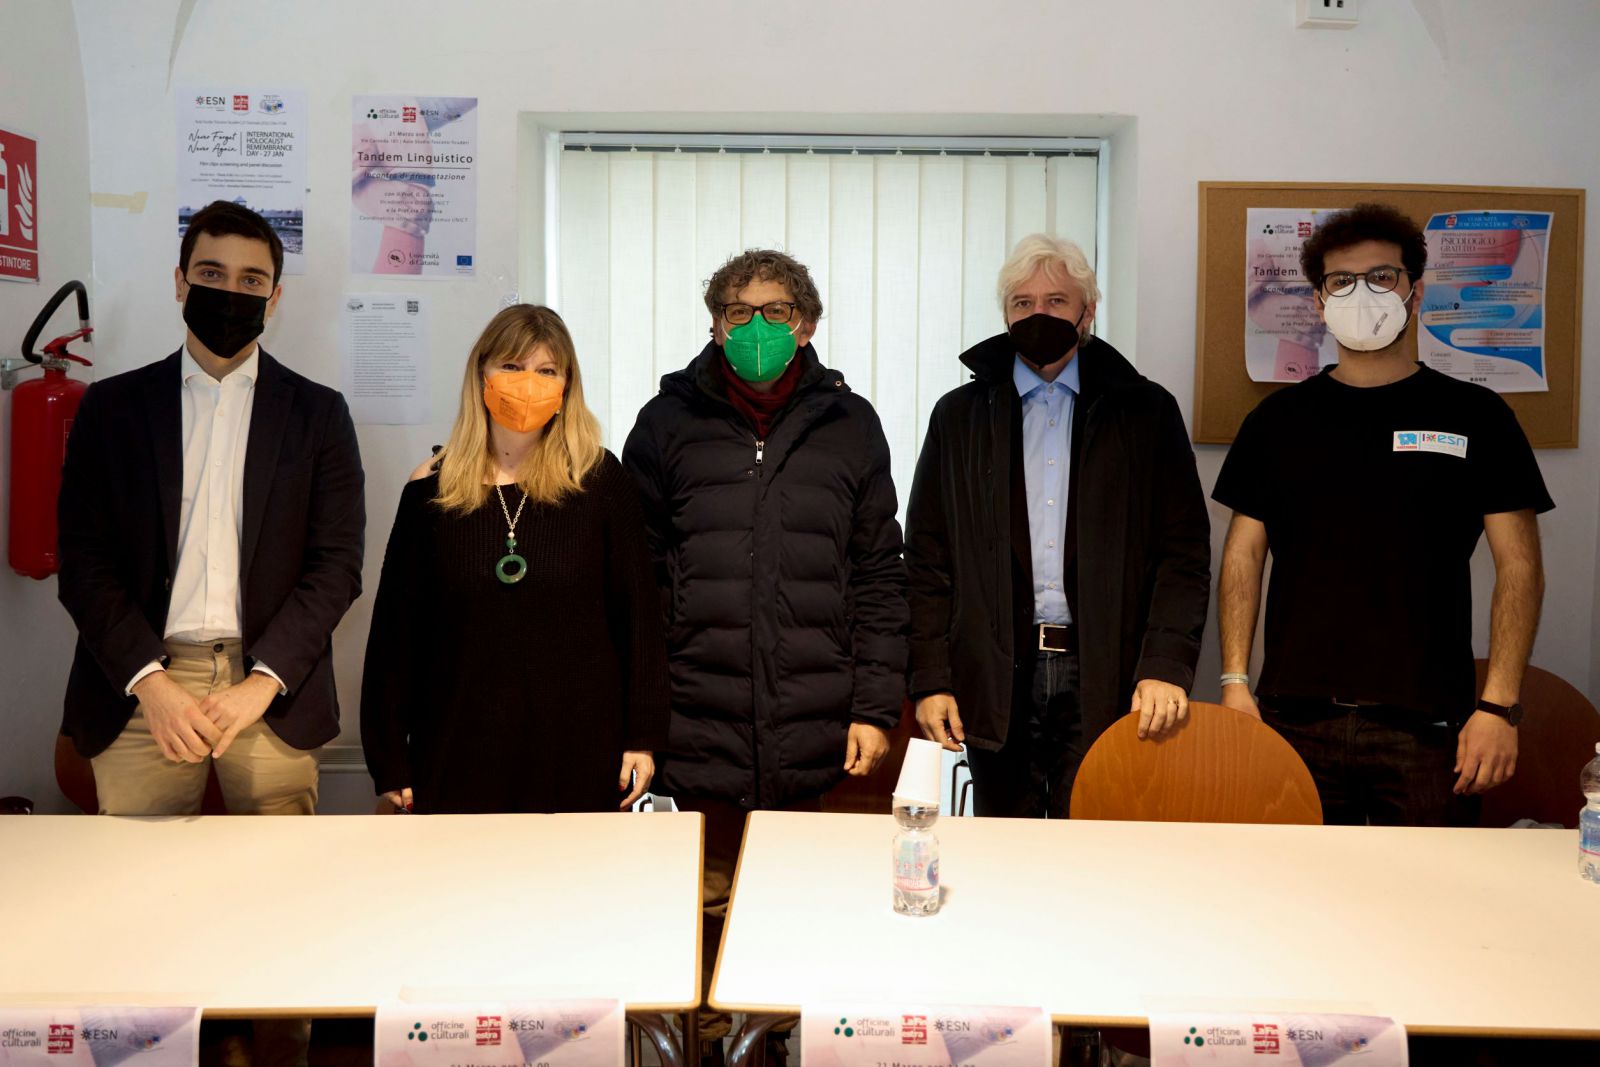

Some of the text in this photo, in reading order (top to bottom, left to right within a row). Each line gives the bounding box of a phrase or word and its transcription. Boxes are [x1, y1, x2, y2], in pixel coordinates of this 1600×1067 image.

[206, 97, 225, 105] ESN
[188, 129, 238, 145] Never Forget
[188, 141, 238, 157] Never Again
[358, 152, 473, 164] Tandem Linguistico
[410, 172, 466, 182] presentazione
[1253, 266, 1298, 276] Tandem
[432, 1022, 464, 1032] officine
[520, 1020, 544, 1030] ESN
[857, 1018, 890, 1029] officine
[946, 1021, 970, 1031] ESN
[2, 1029, 36, 1038] officine
[93, 1030, 118, 1040] ESN
[431, 1031, 469, 1040] culturali
[857, 1027, 895, 1037] culturali
[1207, 1028, 1240, 1038] officine
[1299, 1030, 1323, 1041] ESN
[2, 1039, 41, 1048] culturali
[1207, 1037, 1246, 1046] culturali
